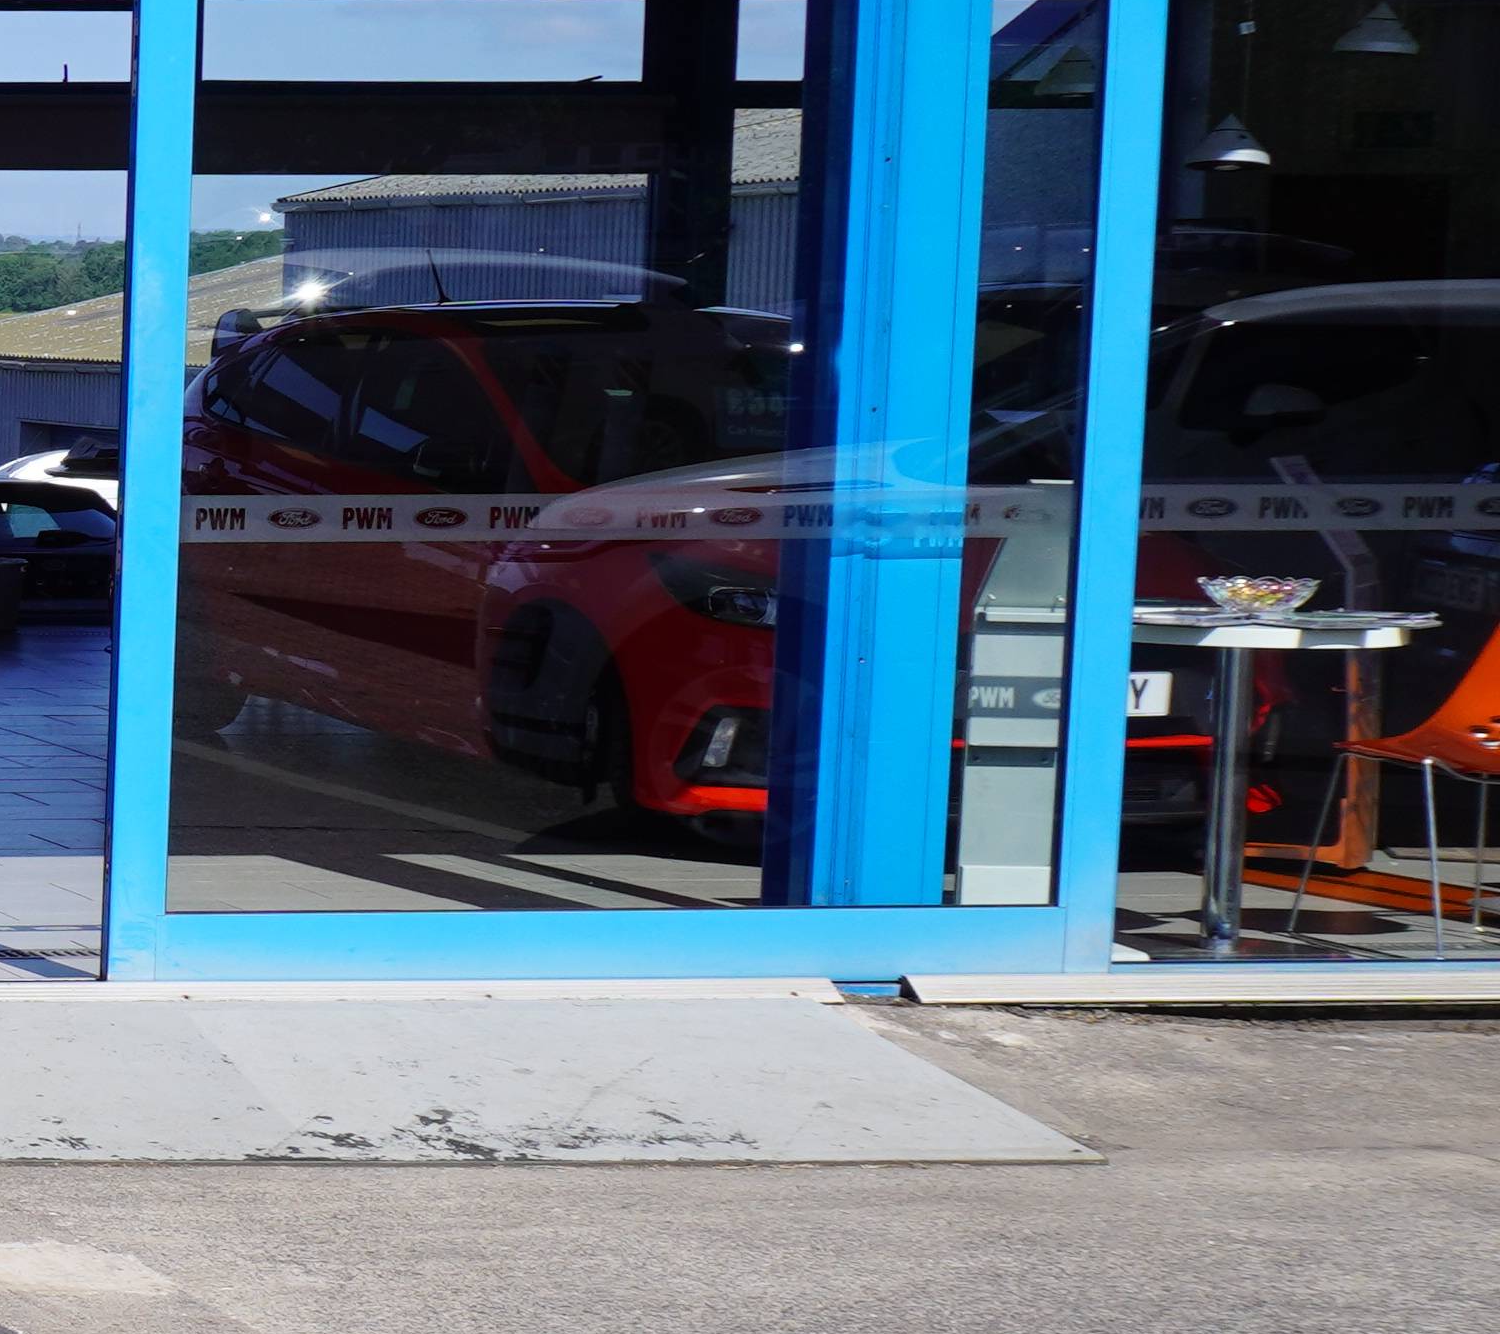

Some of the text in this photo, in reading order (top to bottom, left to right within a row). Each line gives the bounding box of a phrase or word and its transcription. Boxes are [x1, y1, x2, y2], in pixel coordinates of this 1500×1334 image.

[195, 507, 246, 530] PWM
[275, 508, 315, 527] Ford
[342, 507, 393, 530] PWM
[421, 508, 462, 527] Ford
[783, 505, 834, 528] PWM
[1403, 496, 1455, 518] PWM
[968, 685, 1015, 709] PWM
